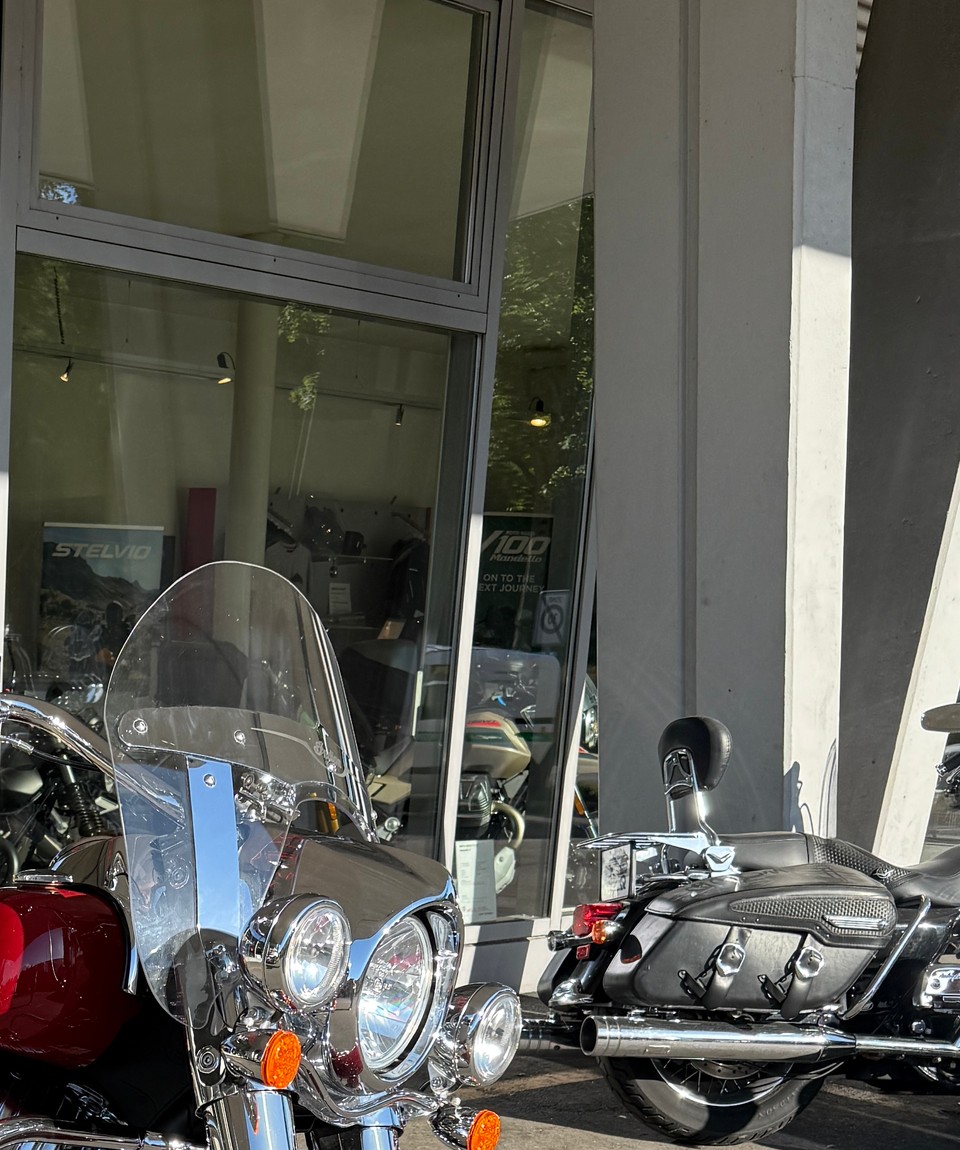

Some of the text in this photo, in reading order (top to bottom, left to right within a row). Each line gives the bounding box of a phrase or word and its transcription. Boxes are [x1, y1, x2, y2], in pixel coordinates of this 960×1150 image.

[51, 543, 152, 559] STELVIO
[489, 553, 542, 562] Mandello
[483, 573, 536, 583] ON TO THE
[478, 583, 545, 593] EXT JOURNEY
